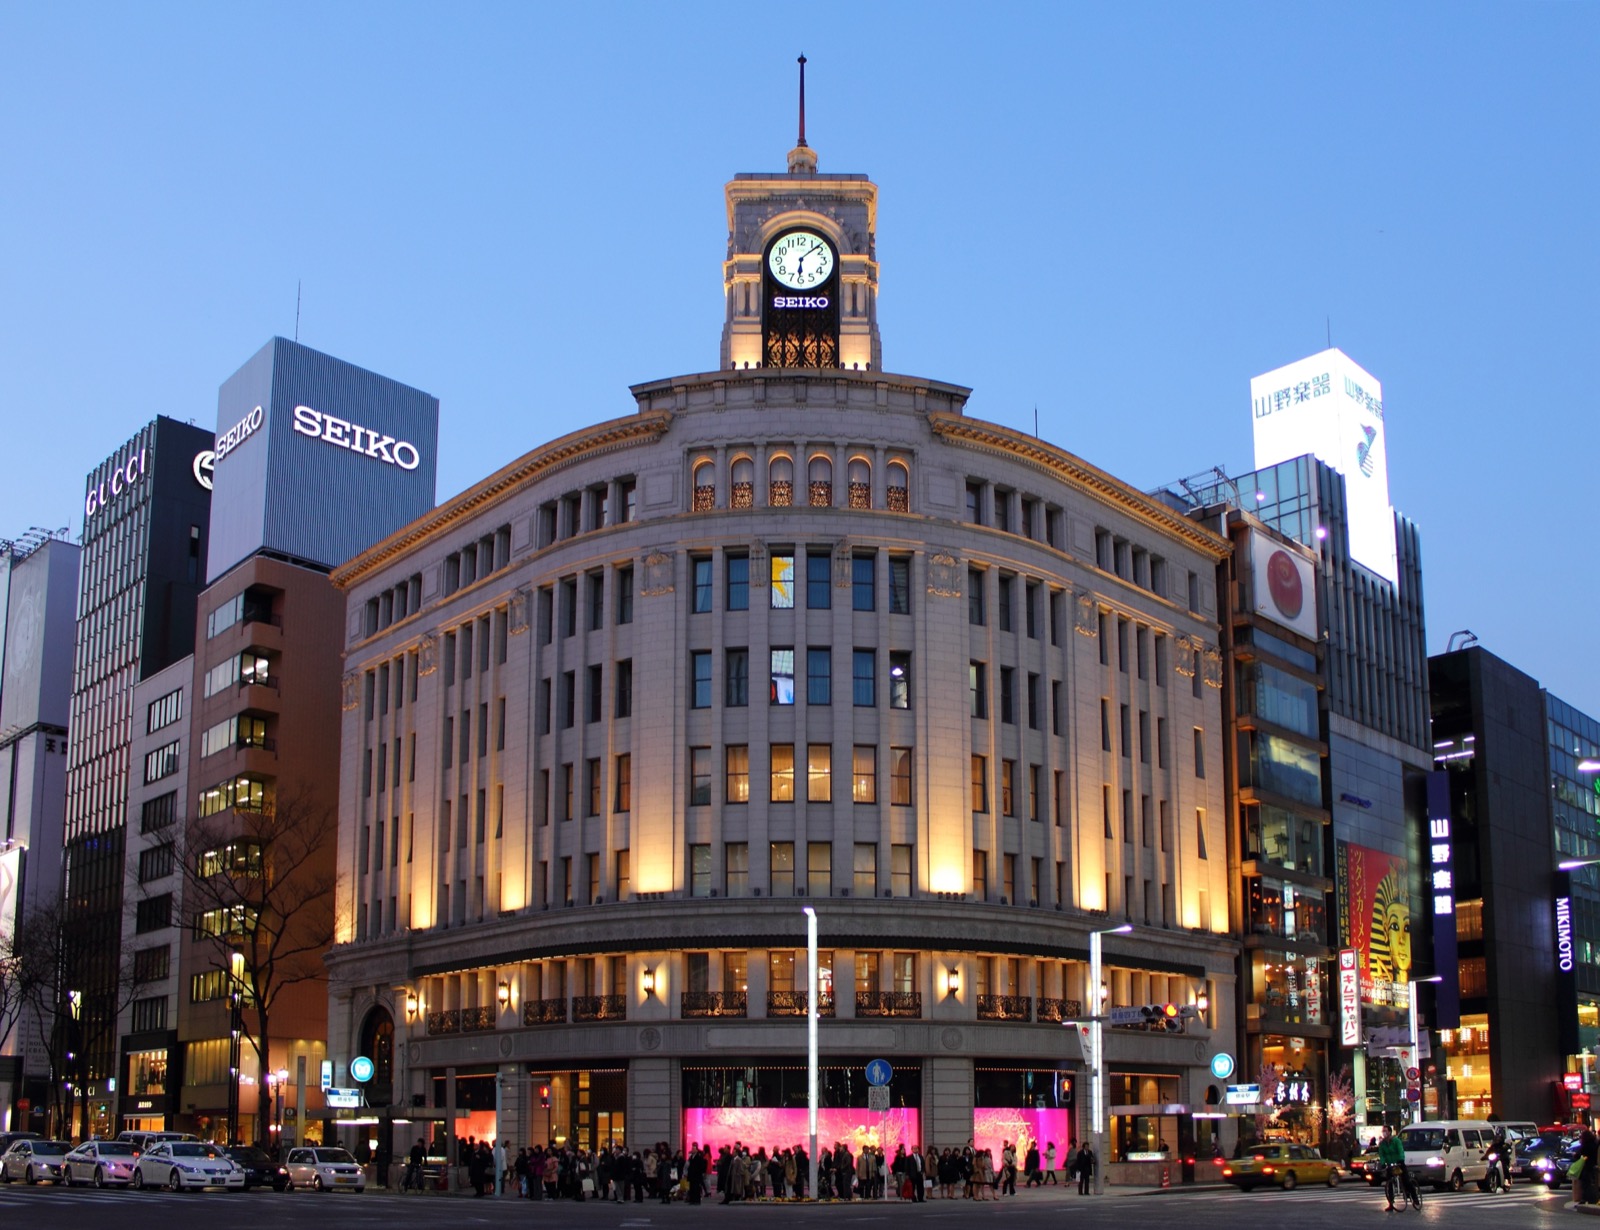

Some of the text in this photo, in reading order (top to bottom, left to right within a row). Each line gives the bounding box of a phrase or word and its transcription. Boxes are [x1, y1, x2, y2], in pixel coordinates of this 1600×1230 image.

[787, 240, 795, 248] 11
[797, 237, 806, 246] 12
[811, 240, 814, 248] 1
[778, 247, 787, 256] 10
[817, 247, 824, 256] 2
[775, 256, 783, 265] 9
[820, 257, 827, 266] 3
[778, 266, 786, 275] 8
[816, 267, 824, 275] 4
[788, 273, 795, 282] 7
[797, 274, 805, 284] 6
[808, 273, 815, 282] 5
[774, 297, 828, 308] SEIKO
[215, 405, 264, 461] SEIKO
[294, 405, 420, 470] SEIKO
[86, 449, 146, 516] GUCCI
[1355, 850, 1367, 969] ツタンカーメン展
[1556, 897, 1573, 971] MIKIMOTO
[1343, 974, 1357, 1041] キムラヤのパン
[74, 1086, 95, 1097] GUCI
